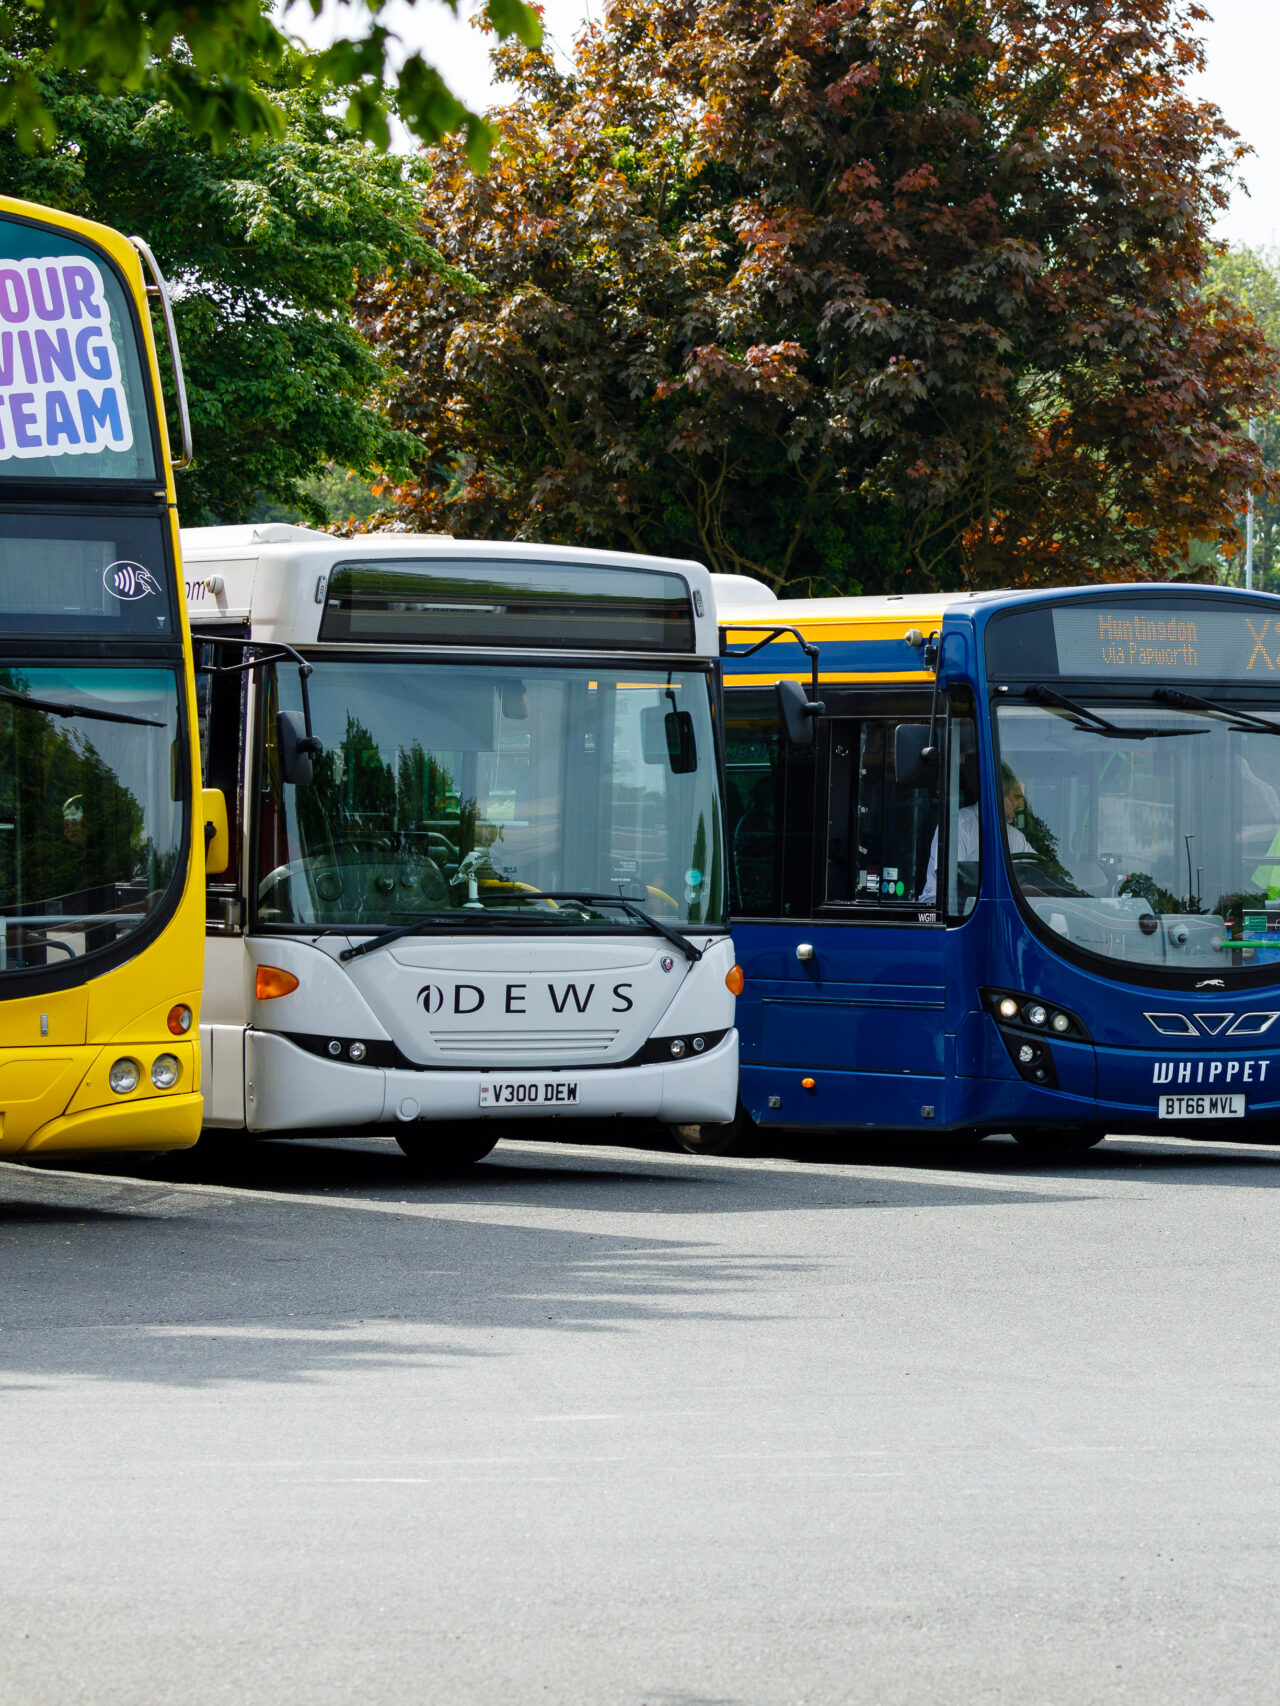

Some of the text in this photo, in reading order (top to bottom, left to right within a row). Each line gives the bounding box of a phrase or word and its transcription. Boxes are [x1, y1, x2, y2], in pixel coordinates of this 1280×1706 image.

[0, 265, 102, 323] OUR
[1101, 642, 1125, 665] via
[453, 983, 634, 1014] DEWS
[1152, 1061, 1270, 1083] WHIPPET
[493, 1083, 577, 1102] V300 DEW
[1165, 1097, 1238, 1115] BT66 MVL
